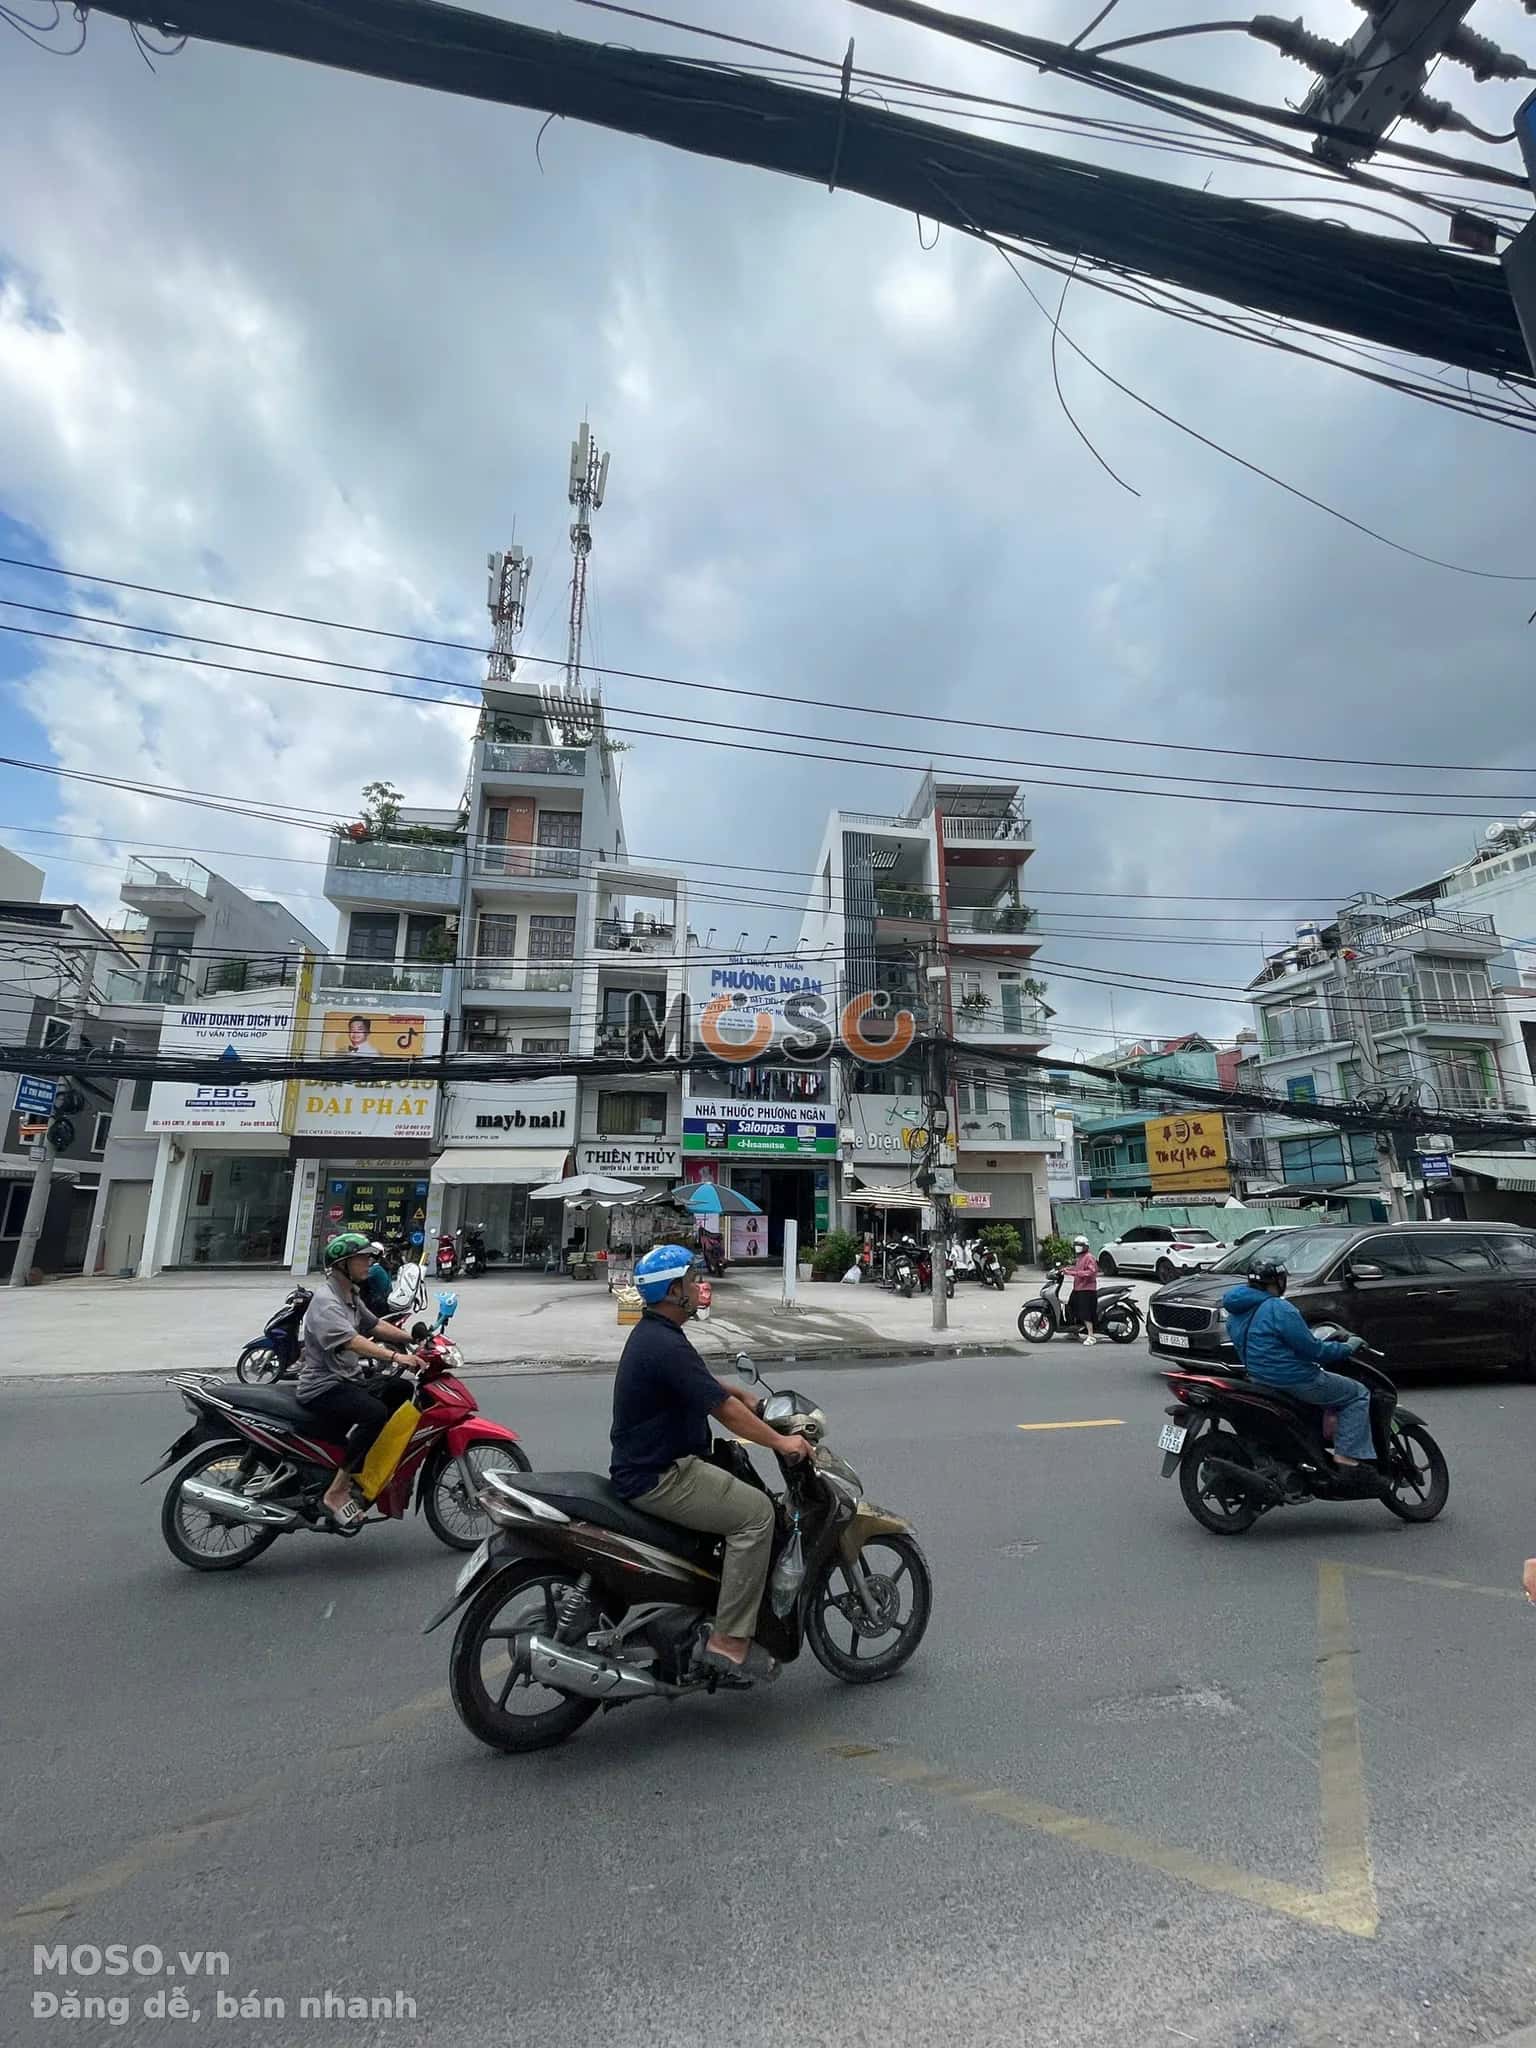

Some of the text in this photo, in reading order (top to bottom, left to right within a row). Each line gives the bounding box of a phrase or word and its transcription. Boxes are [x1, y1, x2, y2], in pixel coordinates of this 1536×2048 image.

[711, 969, 776, 992] PHƯƠNG
[181, 1012, 288, 1030] KINH DOANH DỊCH VỤ
[197, 1088, 249, 1098] FBG
[305, 1094, 429, 1117] ĐẠI PHÁT
[695, 1103, 826, 1121] NHÀ THUỐC PHƯƠNG NGÂN
[475, 1110, 566, 1131] mayb nail
[737, 1120, 786, 1135] Salonpas
[868, 1133, 901, 1155] Điện
[585, 1147, 676, 1164] THIÊN THỦY
